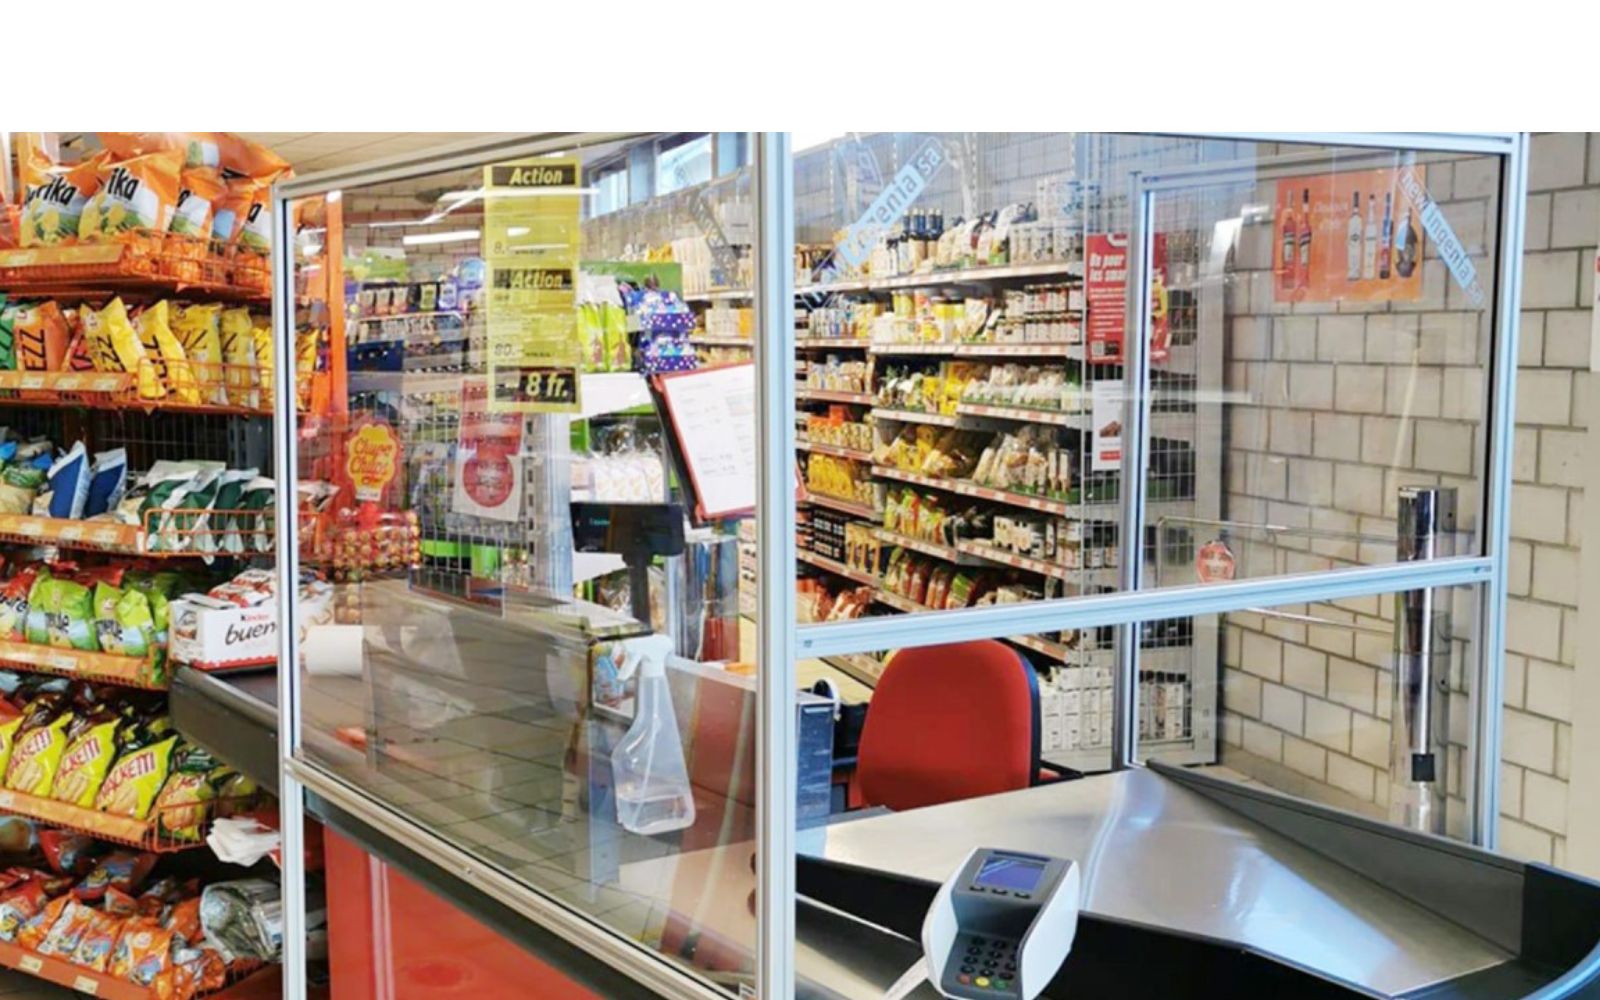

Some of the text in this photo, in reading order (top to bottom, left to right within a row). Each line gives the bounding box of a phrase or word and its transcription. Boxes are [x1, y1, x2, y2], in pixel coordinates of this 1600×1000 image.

[917, 147, 942, 176] sa
[509, 166, 563, 186] Action
[1424, 207, 1470, 281] ingenia
[510, 269, 564, 289] Action
[525, 372, 542, 396] 8
[225, 621, 278, 646] buen
